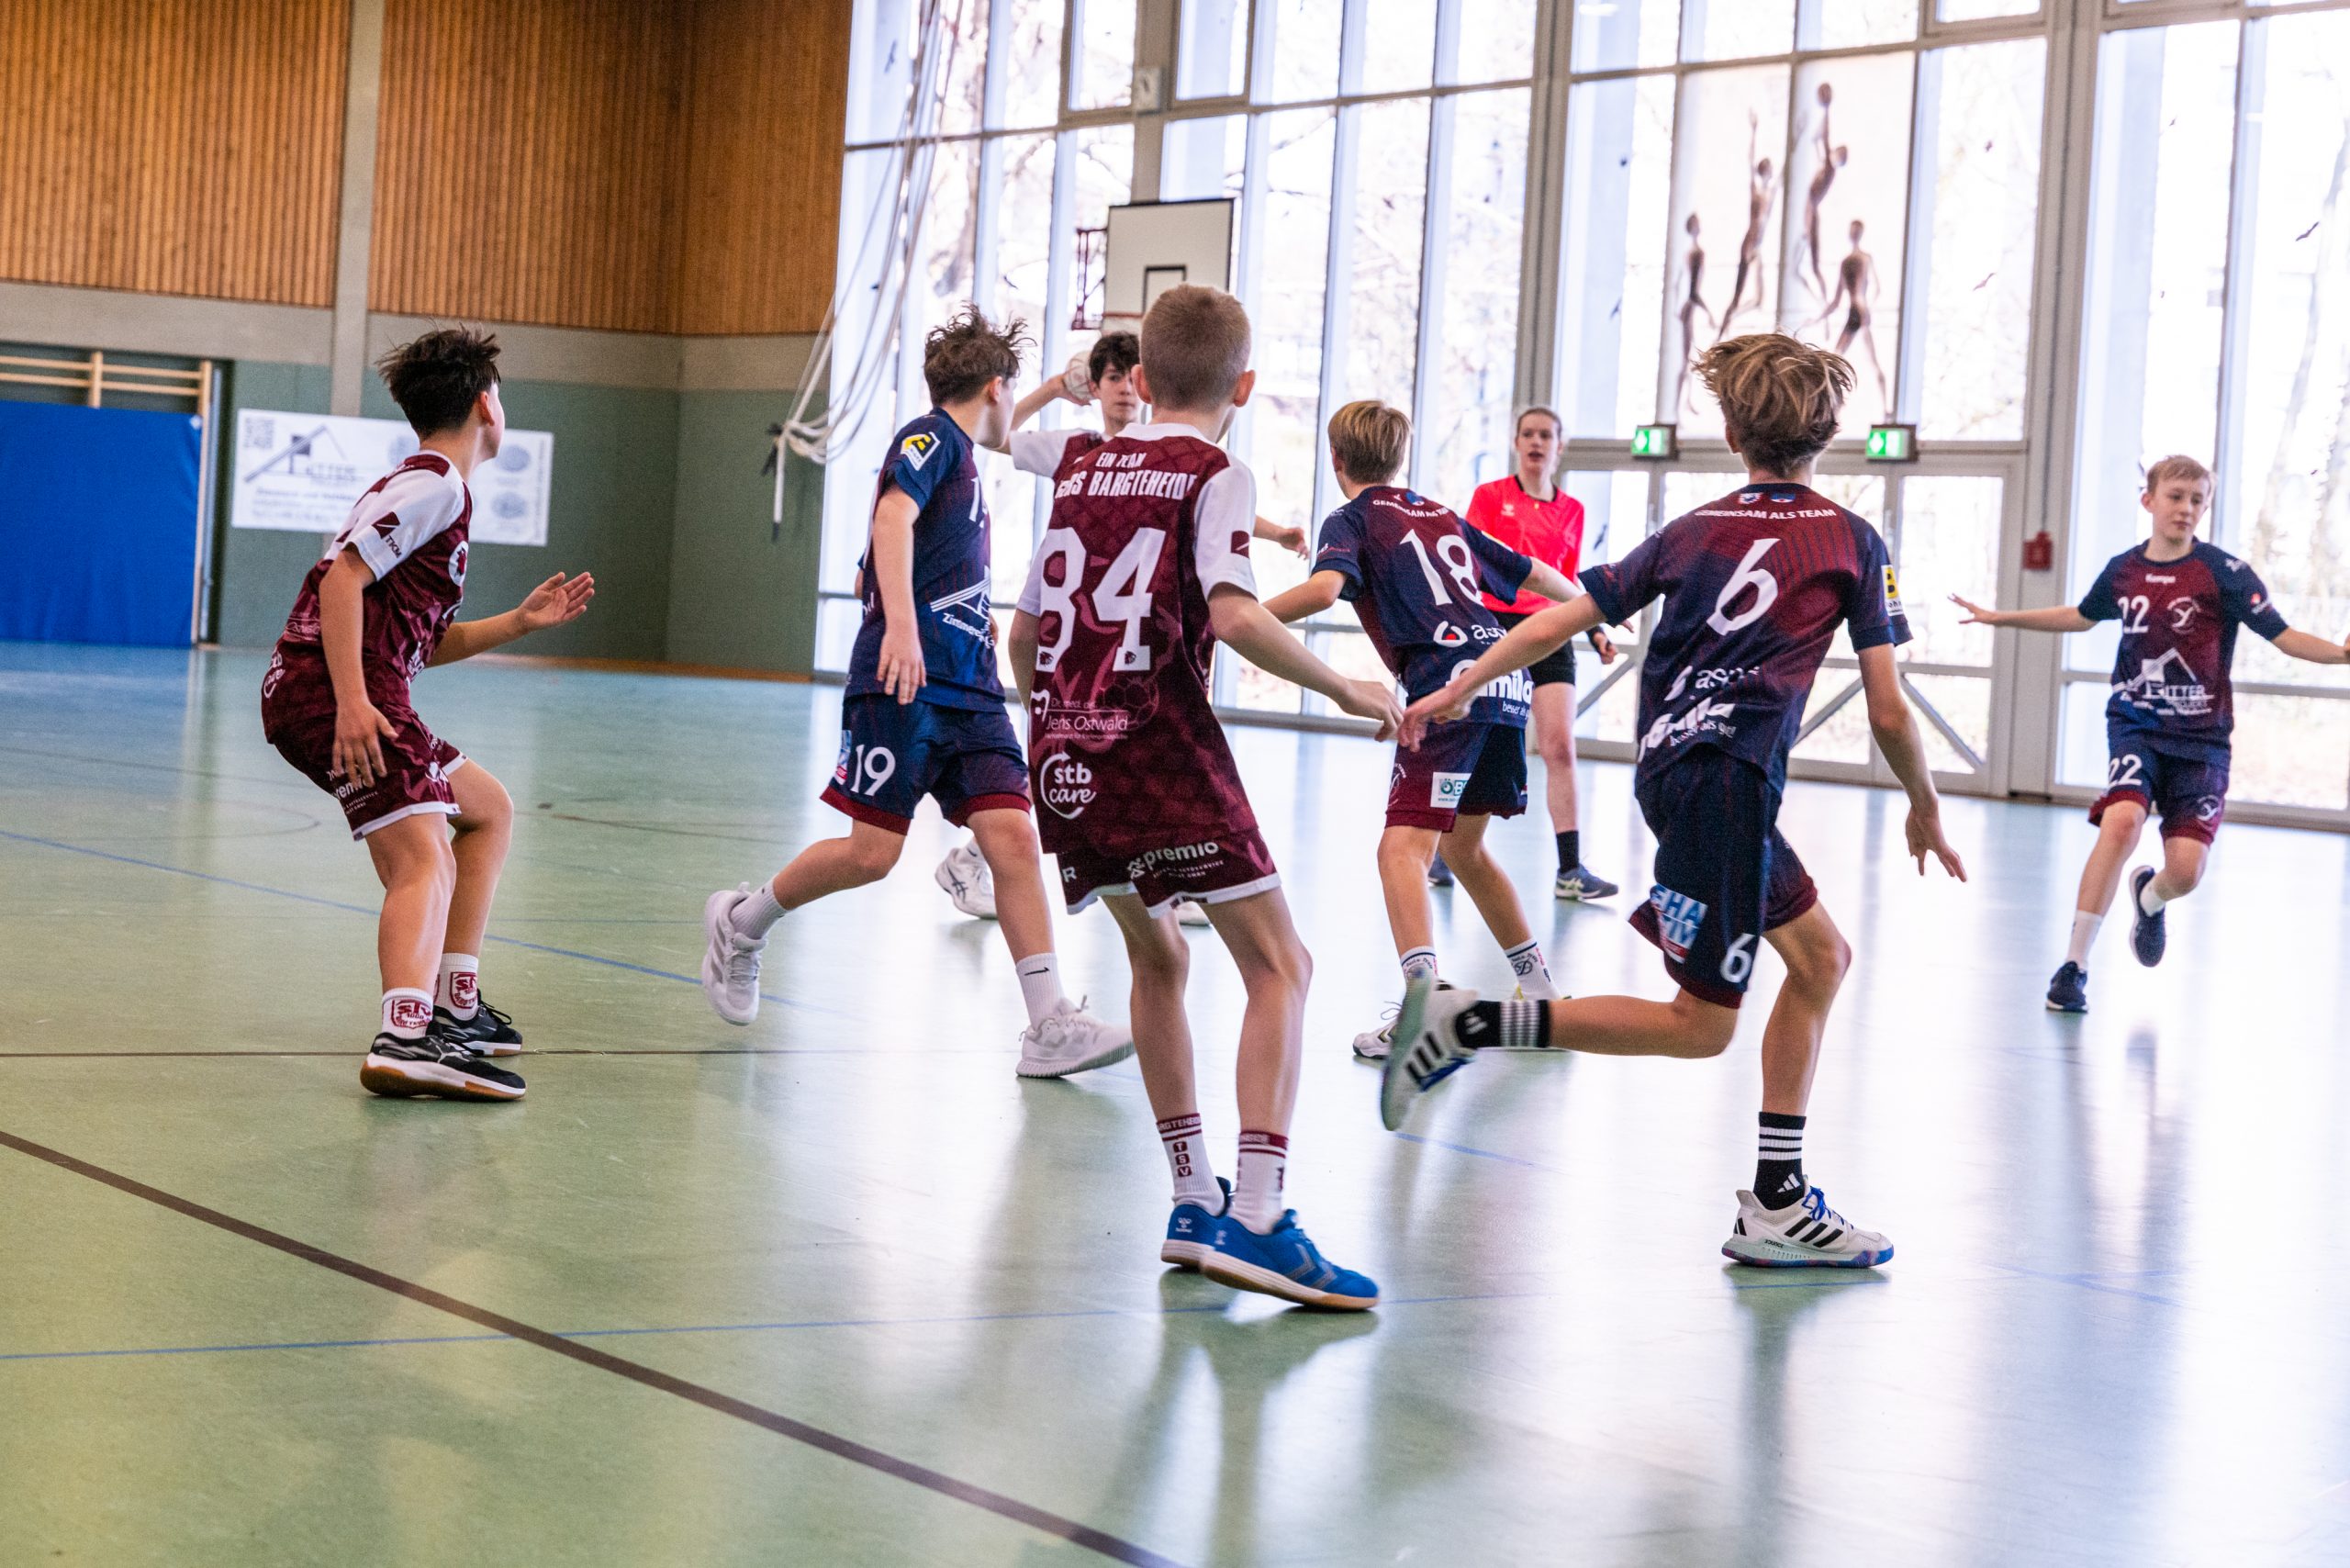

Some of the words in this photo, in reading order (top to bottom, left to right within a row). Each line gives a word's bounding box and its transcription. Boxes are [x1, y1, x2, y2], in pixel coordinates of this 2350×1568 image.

[1096, 452, 1117, 467] EIN
[1768, 511, 1796, 520] ALS
[1797, 510, 1836, 519] TEAM
[1399, 528, 1484, 608] 18
[1035, 526, 1167, 673] 84
[1706, 538, 1782, 636] 6
[1046, 715, 1071, 730] Jens
[1074, 715, 1128, 731] Ostwald
[850, 745, 896, 797] 19
[1054, 762, 1092, 784] stb
[1048, 788, 1097, 803] care
[1143, 842, 1219, 871] premio
[1719, 933, 1755, 983] 6
